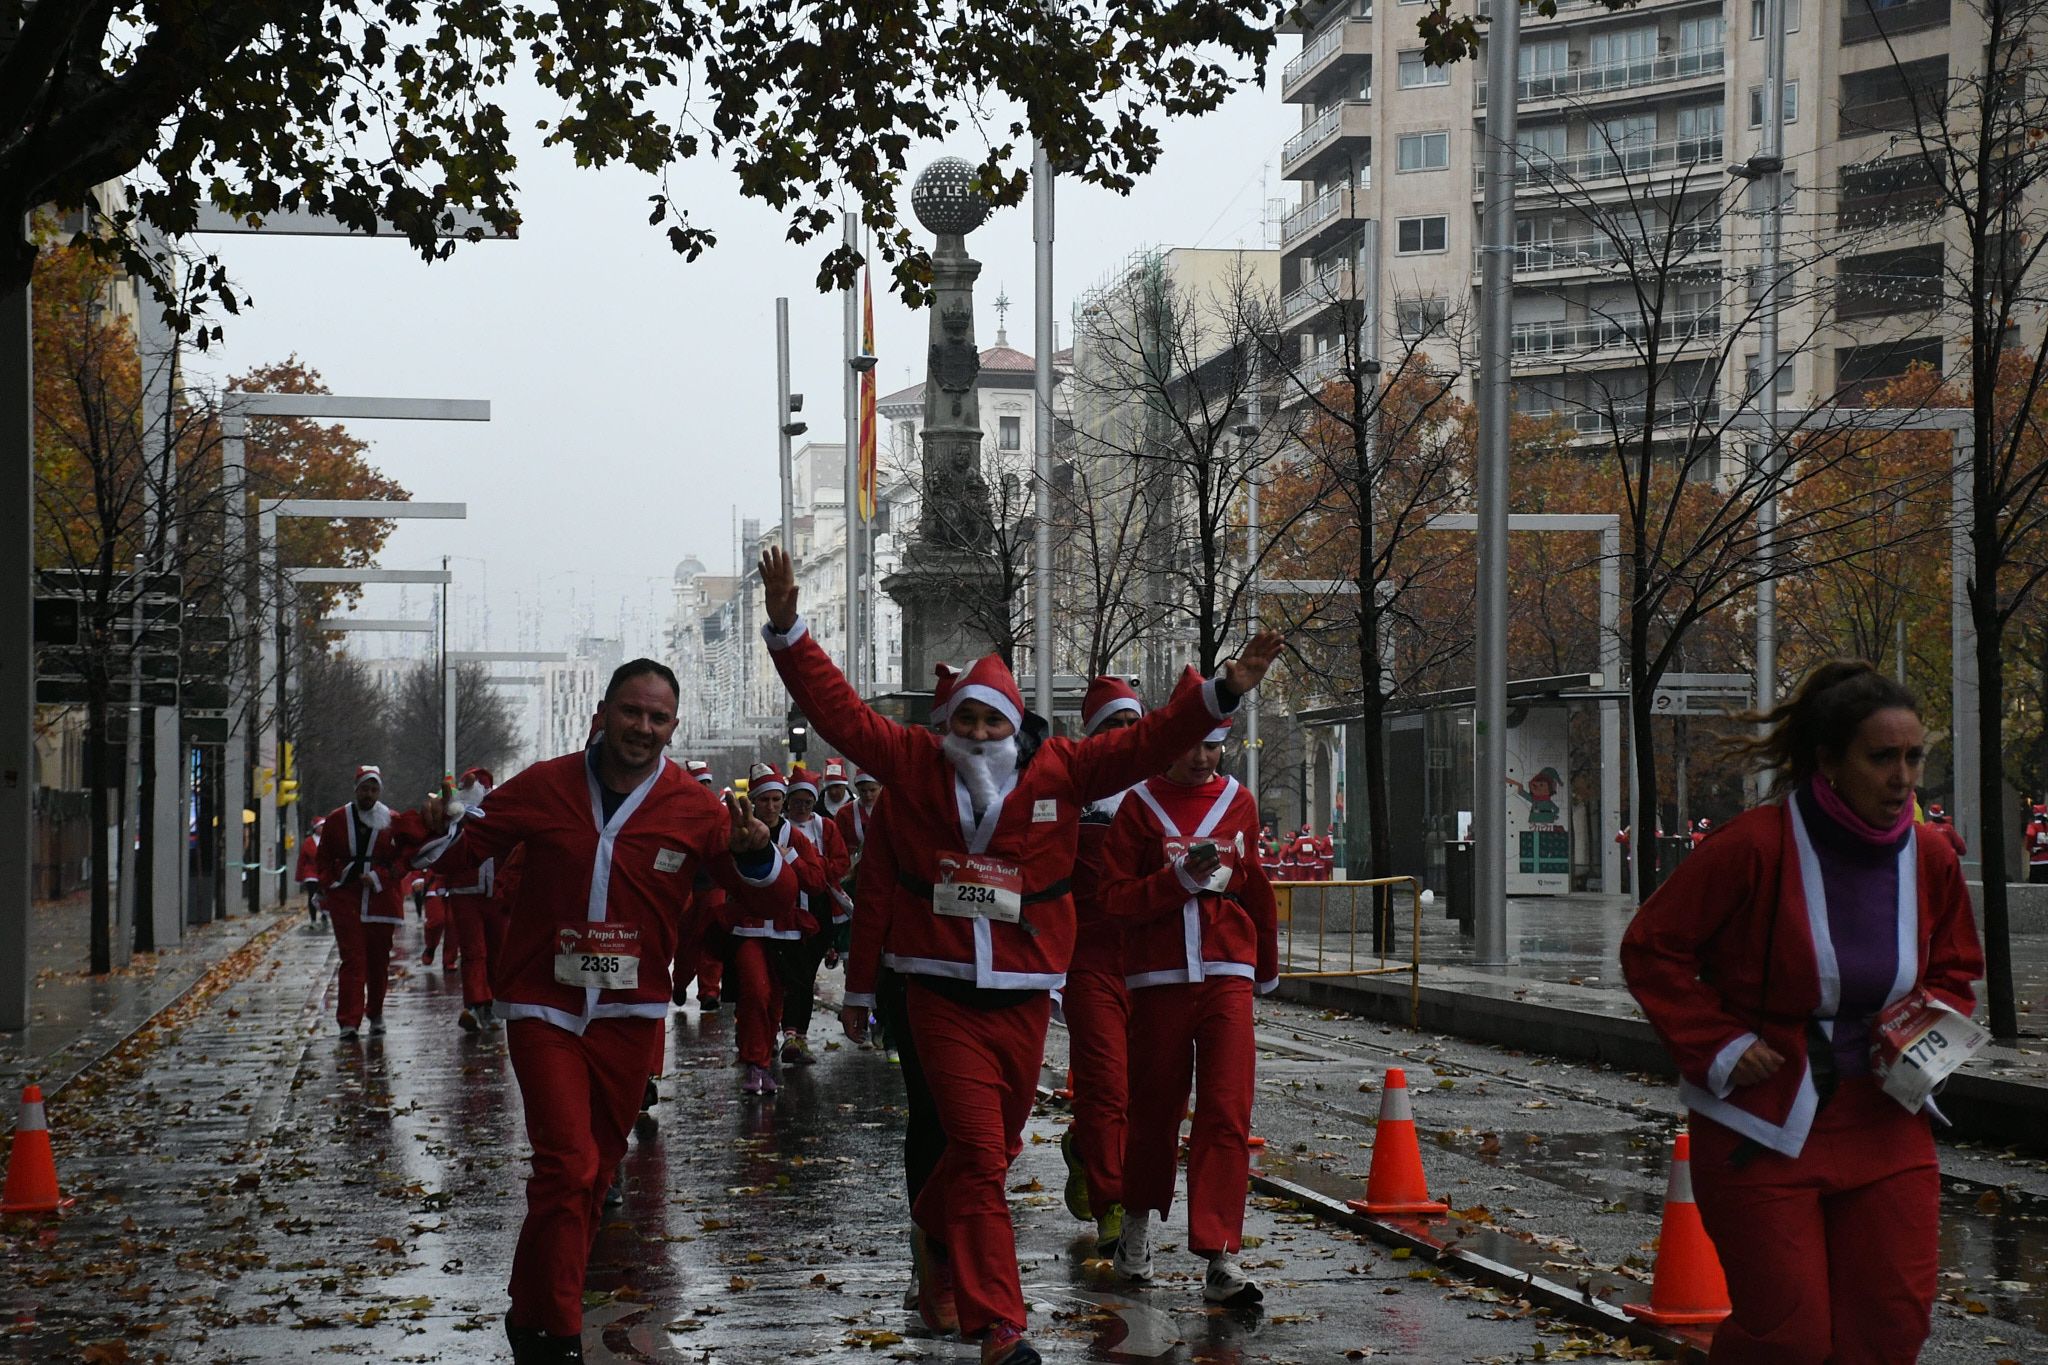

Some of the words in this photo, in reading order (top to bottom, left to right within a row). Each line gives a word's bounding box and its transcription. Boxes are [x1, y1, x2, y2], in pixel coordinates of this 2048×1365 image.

[946, 186, 970, 197] LEY
[966, 860, 993, 873] Papá
[996, 864, 1019, 876] Noel
[957, 885, 996, 904] 2334
[587, 928, 615, 941] Papá
[617, 930, 639, 940] Noel
[580, 955, 619, 973] 2335
[1902, 1030, 1949, 1069] 1779
